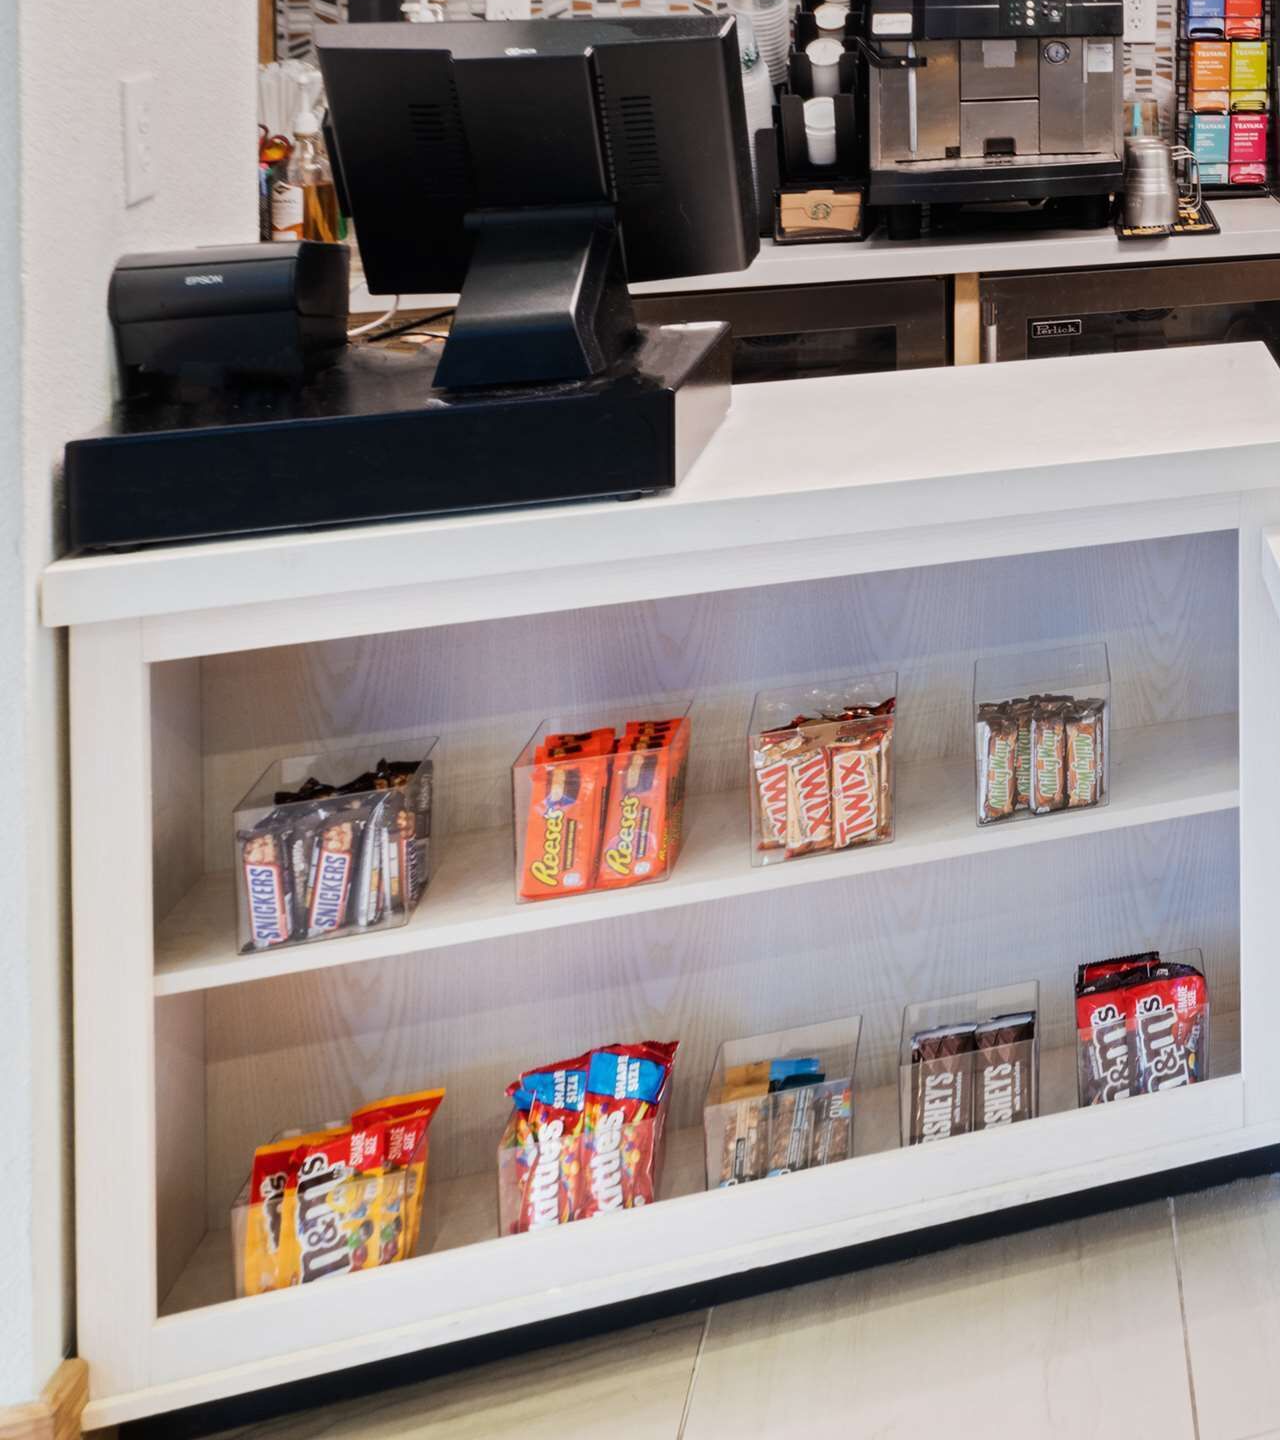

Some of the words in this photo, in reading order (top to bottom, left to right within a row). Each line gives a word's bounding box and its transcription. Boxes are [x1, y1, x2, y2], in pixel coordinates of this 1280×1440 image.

[185, 274, 223, 286] EPSON
[1036, 324, 1077, 335] Perlick
[798, 746, 831, 834] TWIX
[839, 756, 874, 846] TWIX
[250, 868, 281, 941] SNICKERS
[315, 855, 347, 928] SNICKERS
[566, 1074, 579, 1103] SIZE
[615, 1055, 630, 1100] SHARE
[627, 1061, 641, 1091] SIZE
[351, 1130, 366, 1166] SHARE
[365, 1135, 378, 1156] SIZE
[389, 1126, 405, 1160] SHARE
[403, 1130, 416, 1150] SIZE
